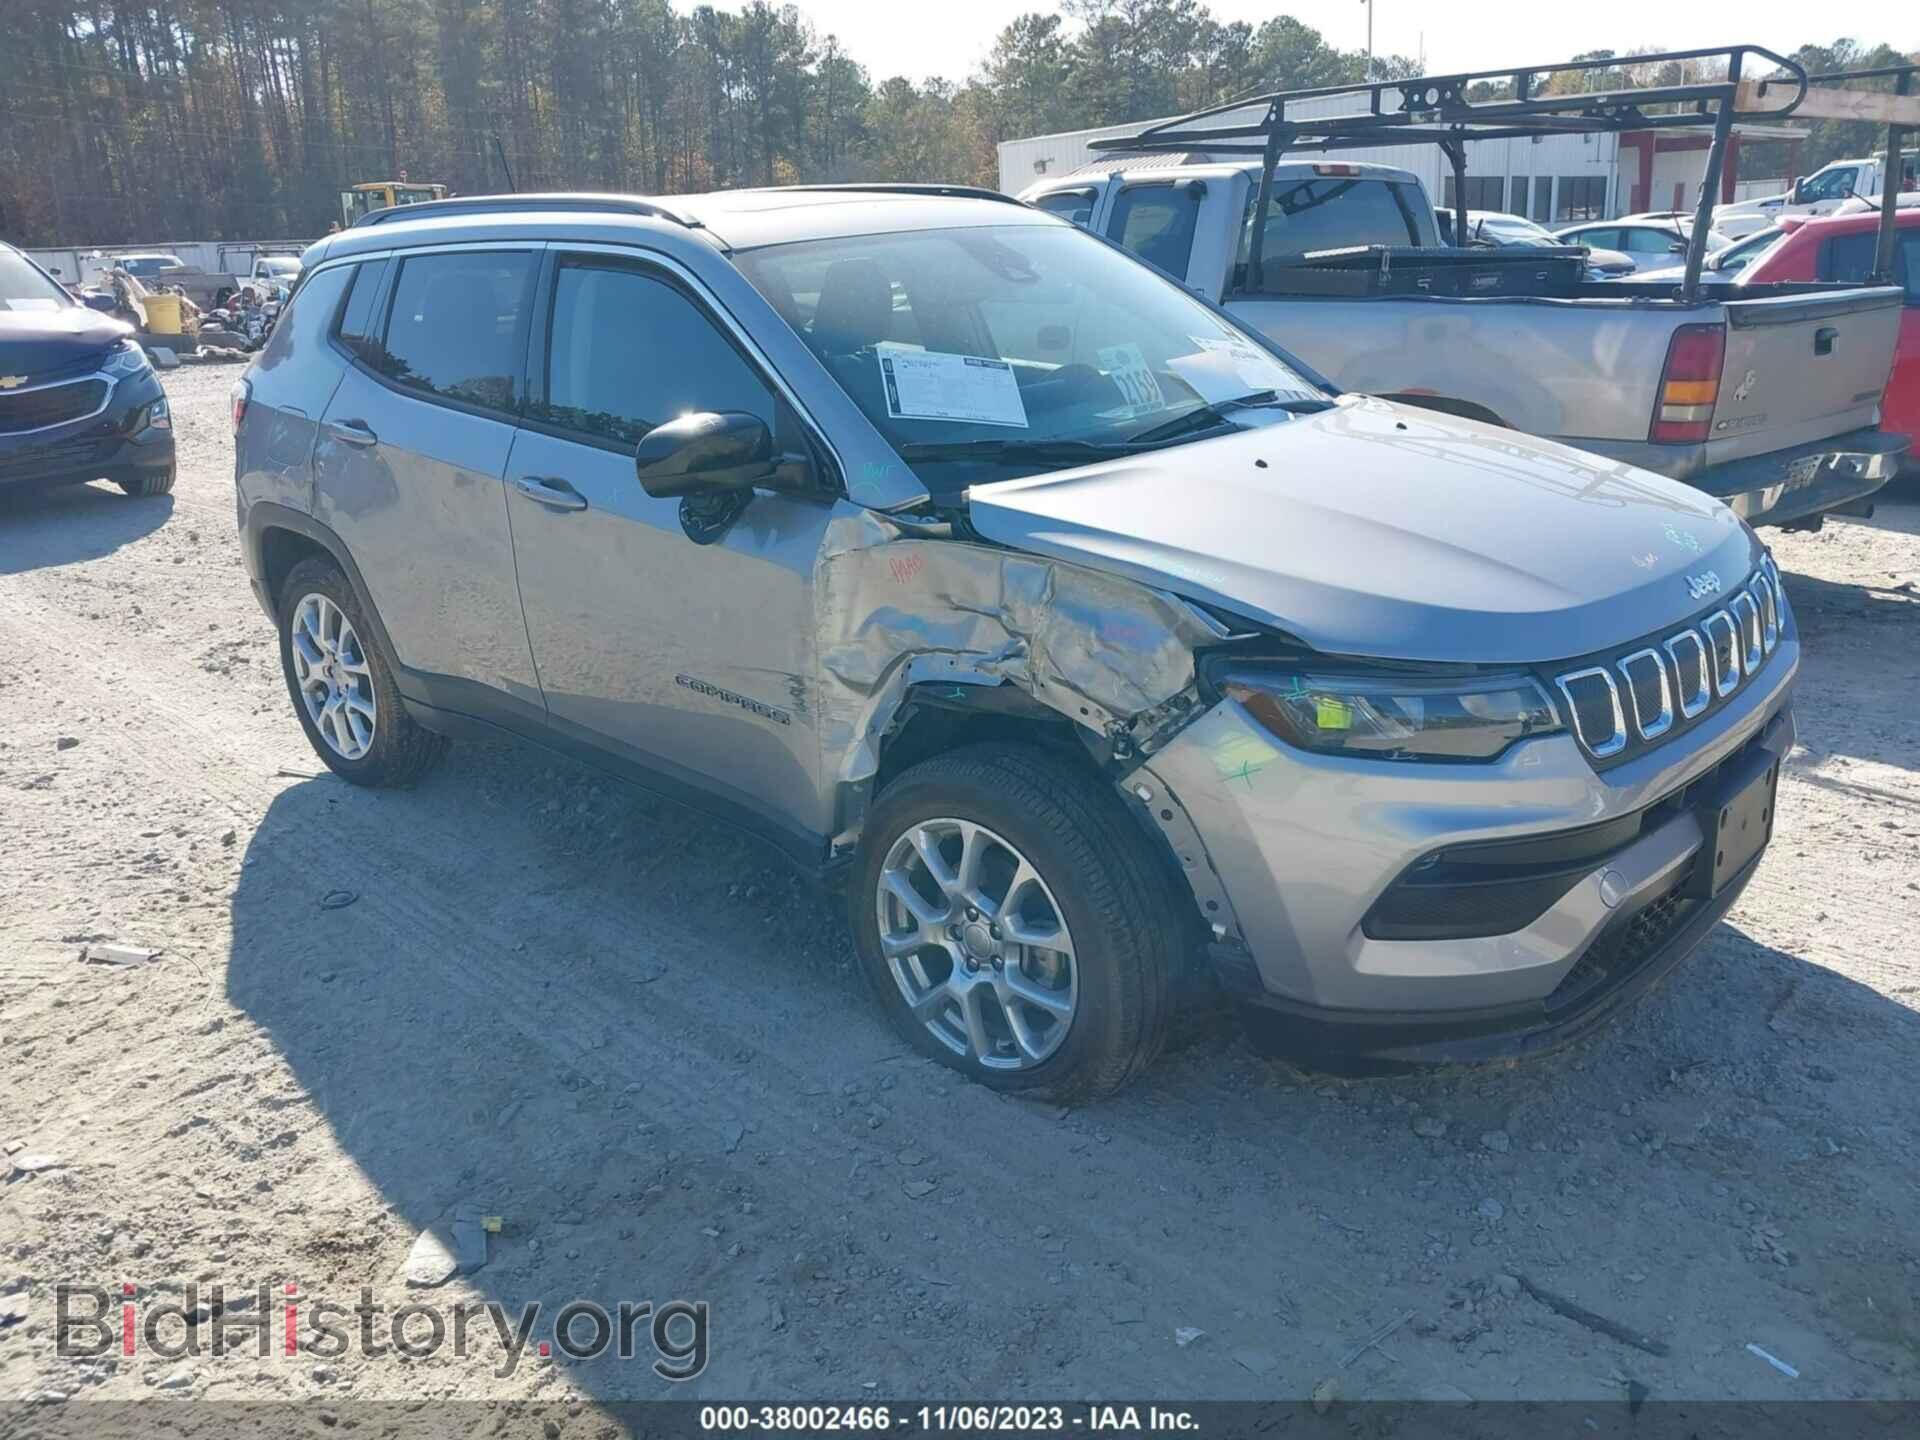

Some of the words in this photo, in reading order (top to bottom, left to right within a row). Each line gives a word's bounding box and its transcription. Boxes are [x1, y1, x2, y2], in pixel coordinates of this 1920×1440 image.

[1115, 369, 1160, 405] 2159
[1685, 571, 1721, 600] Jeep
[675, 672, 790, 725] COMPASS
